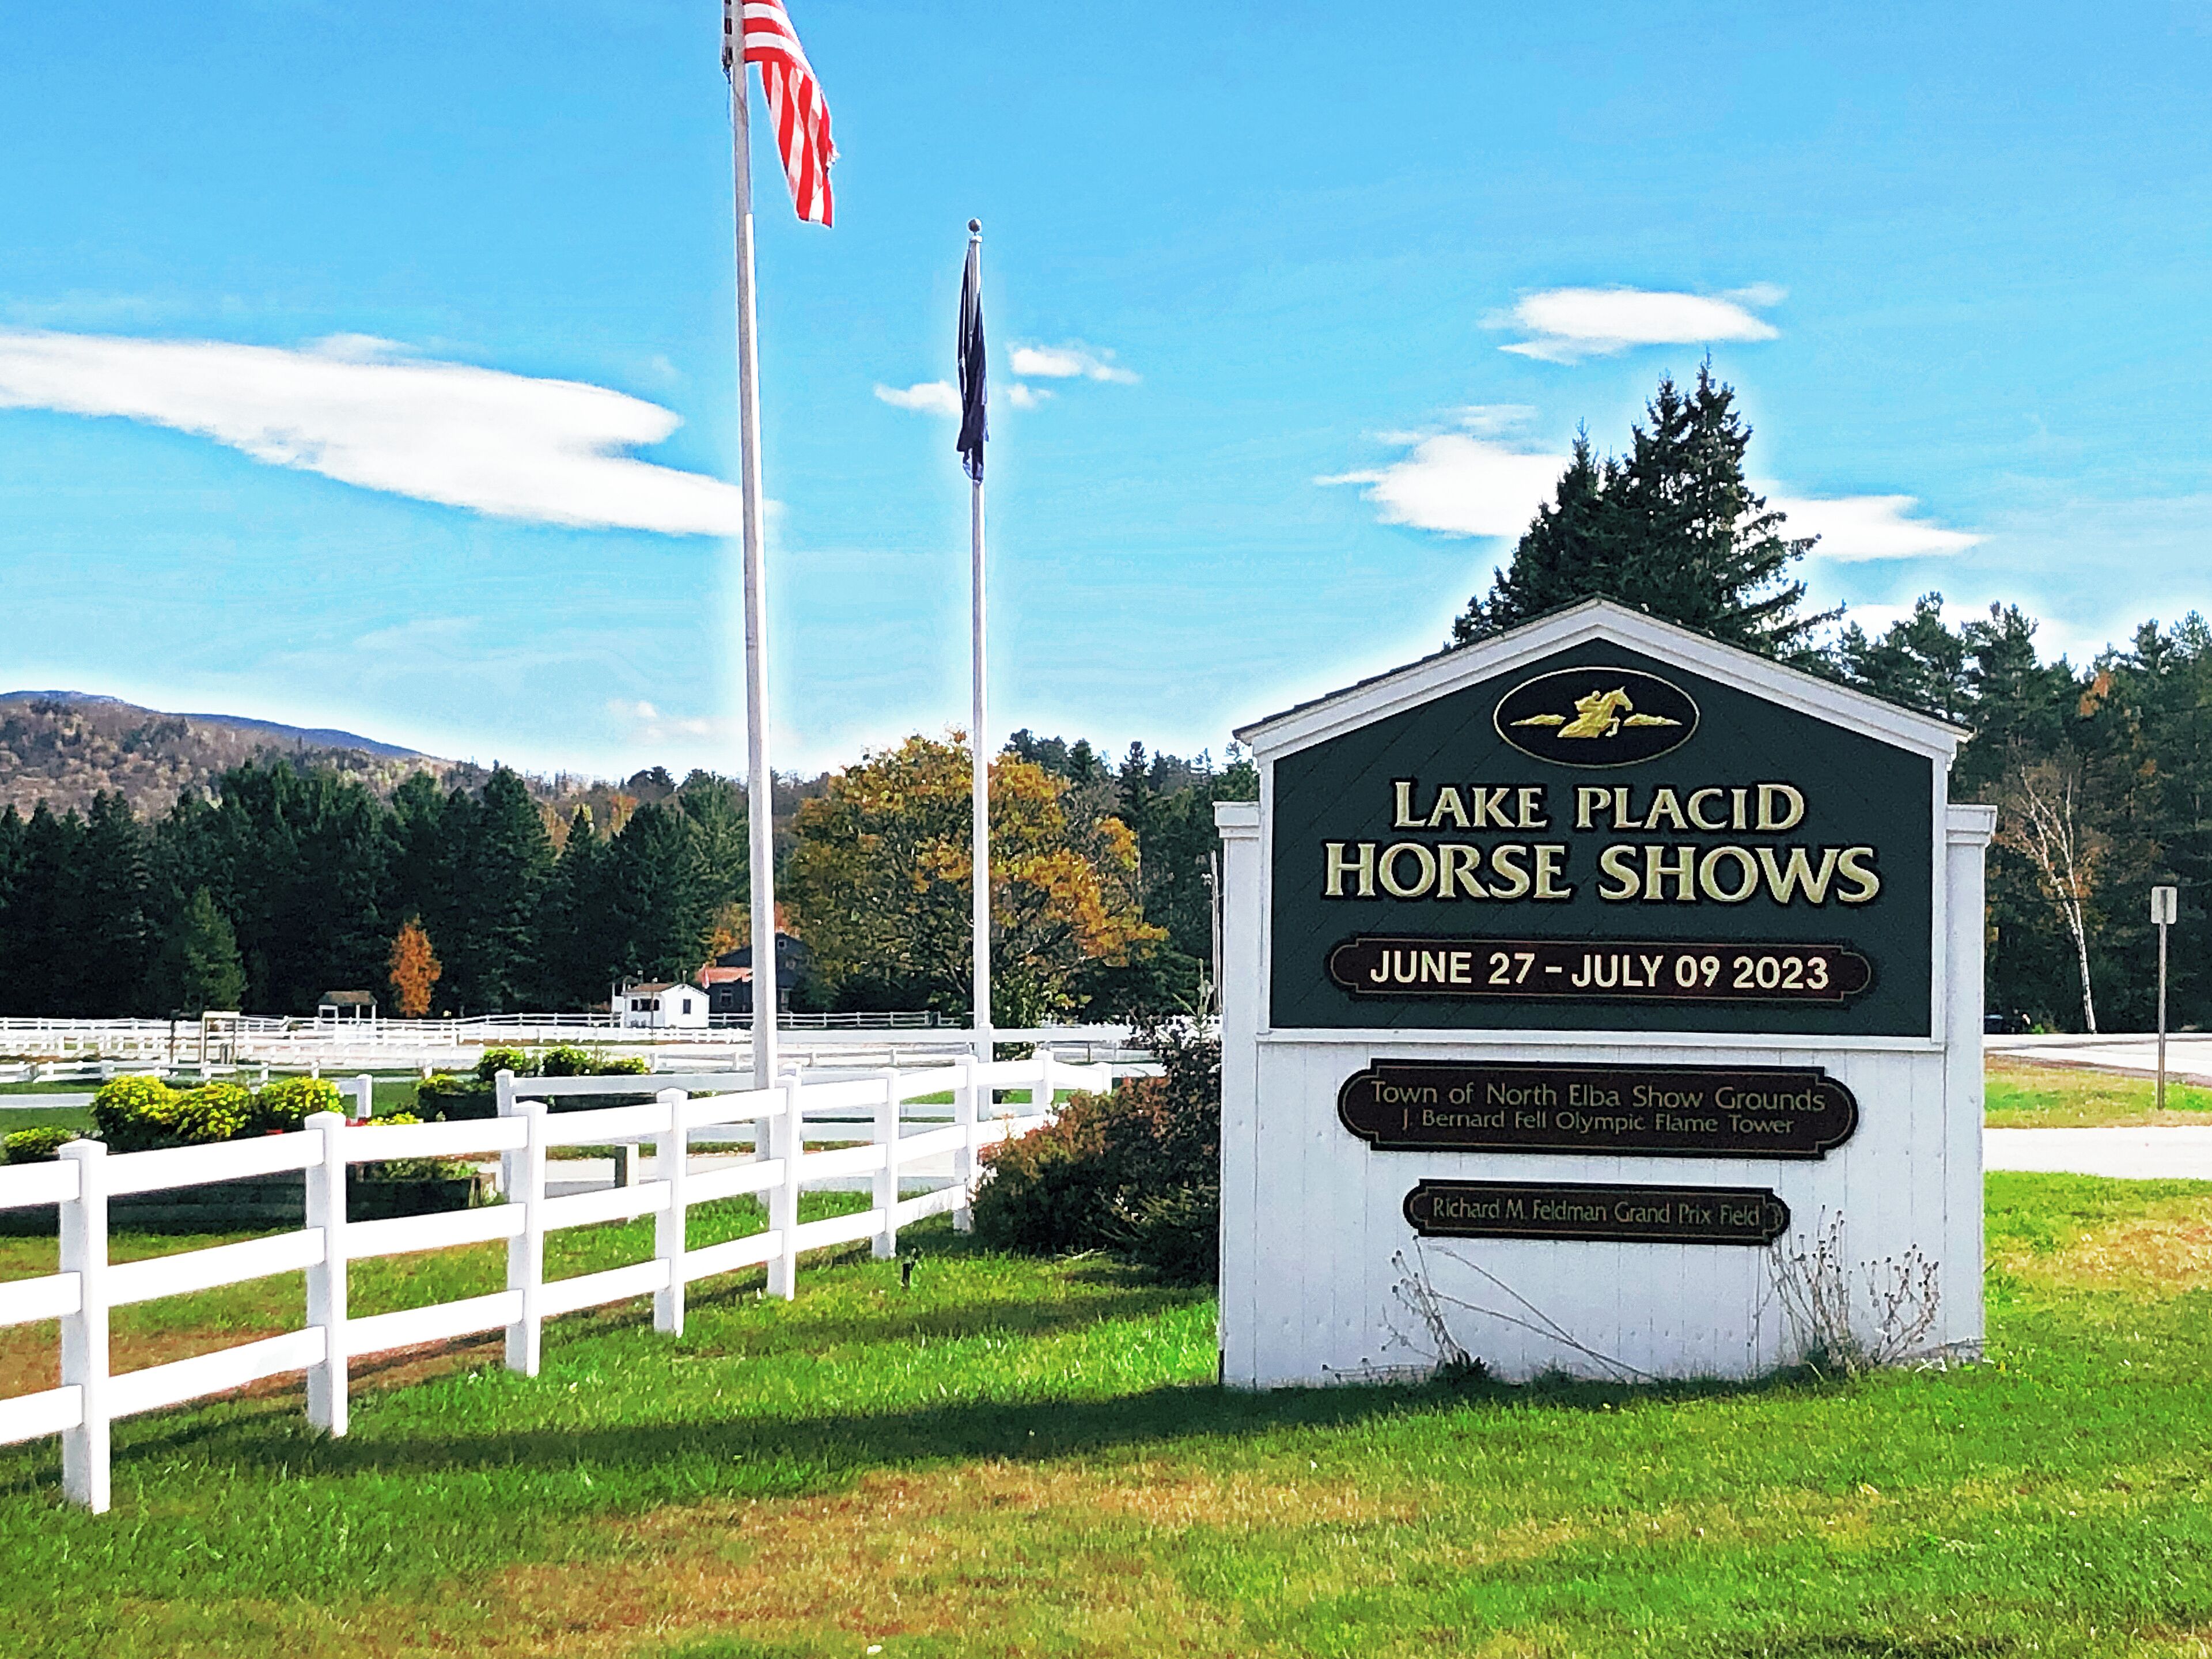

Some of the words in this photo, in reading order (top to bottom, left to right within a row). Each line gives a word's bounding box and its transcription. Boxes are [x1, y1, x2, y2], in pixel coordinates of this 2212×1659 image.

[1394, 781, 1547, 828] LAKE
[1576, 783, 1805, 830] PLACID
[1325, 843, 1571, 899] HORSE
[1599, 844, 1880, 904] SHOWS
[1370, 950, 1472, 983] JUNE
[1488, 952, 1535, 984] 27
[1571, 954, 1664, 987] JULY
[1675, 955, 1720, 988] 09
[1733, 956, 1829, 990] 2023
[1370, 1081, 1438, 1104] Town
[1448, 1081, 1475, 1105] of
[1486, 1082, 1556, 1106] North
[1569, 1084, 1621, 1108] Elba
[1632, 1085, 1703, 1109] Show
[1714, 1086, 1826, 1112] Grounds
[1422, 1109, 1505, 1128] Bernard
[1515, 1111, 1547, 1130] Fell
[1556, 1111, 1646, 1135] Olympic
[1655, 1113, 1718, 1133] Flame
[1729, 1114, 1795, 1134] Tower
[1433, 1197, 1500, 1219] Richard
[1532, 1199, 1607, 1222] Feldman
[1614, 1201, 1670, 1224] Grand
[1678, 1203, 1710, 1226] Prix
[1719, 1205, 1760, 1227] Field
